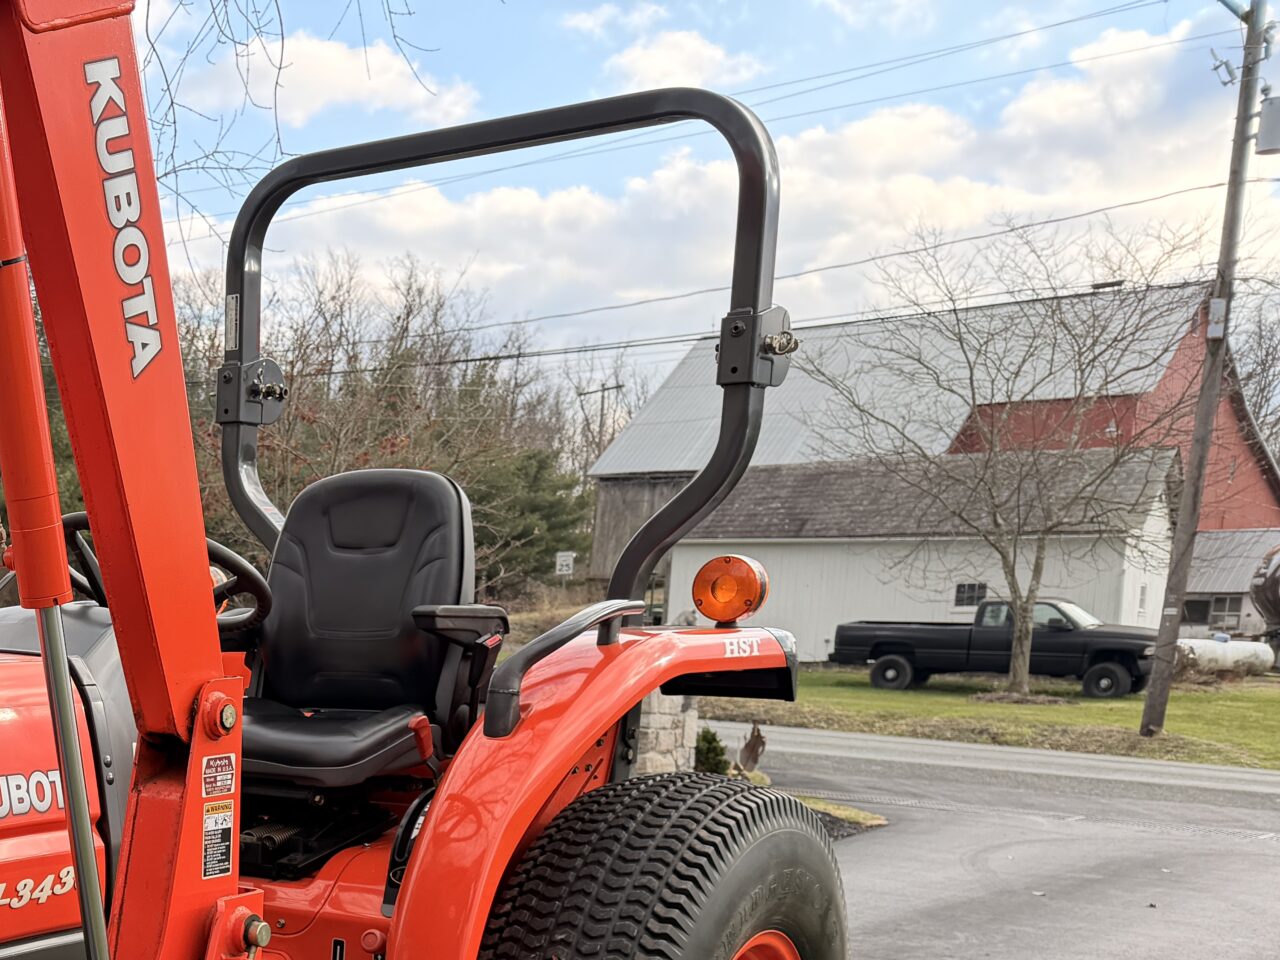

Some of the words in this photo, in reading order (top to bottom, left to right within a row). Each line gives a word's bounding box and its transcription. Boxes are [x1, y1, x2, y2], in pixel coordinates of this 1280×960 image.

[84, 57, 162, 380] KUBOTA
[723, 639, 761, 658] HST
[210, 803, 232, 813] WARNING
